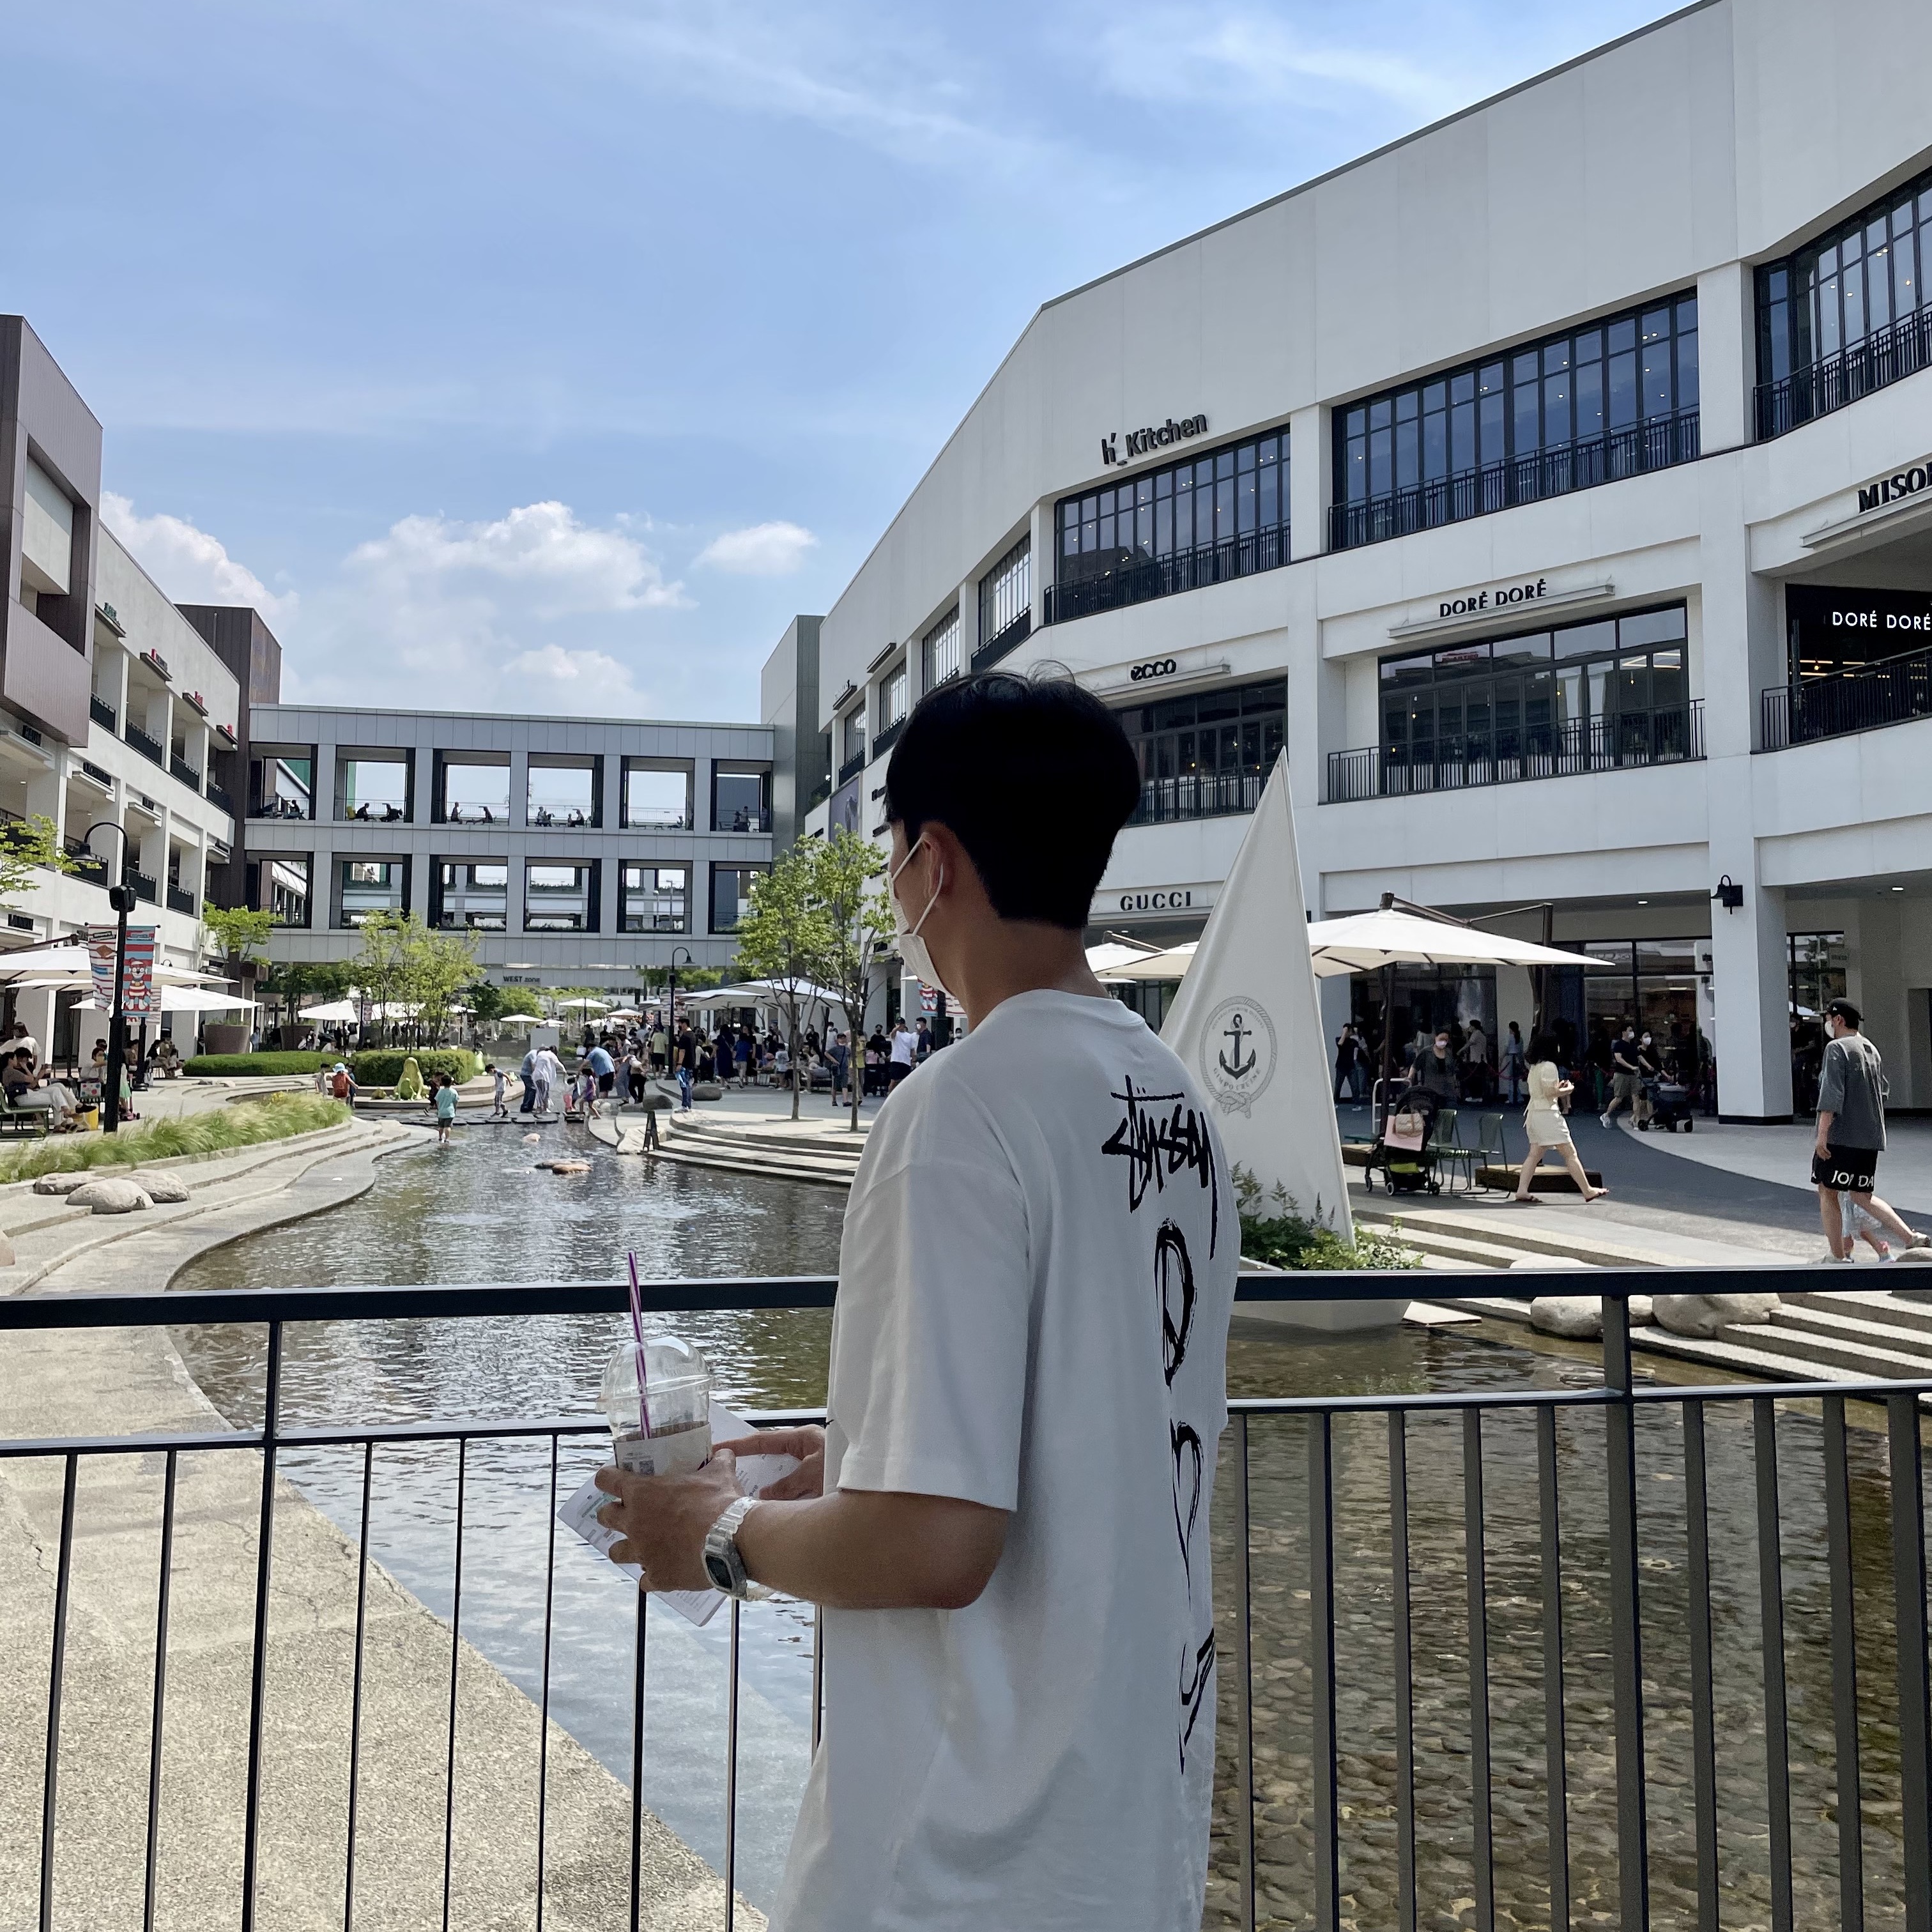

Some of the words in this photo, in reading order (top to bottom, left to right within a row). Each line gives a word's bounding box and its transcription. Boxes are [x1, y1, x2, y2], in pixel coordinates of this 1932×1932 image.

[1440, 591, 1488, 617] DORÉ
[1496, 578, 1547, 606] DORÉ
[1832, 610, 1877, 628] DORÉ
[1887, 613, 1931, 631] DORÉ
[1131, 659, 1176, 682] ecco
[1120, 891, 1191, 911] GUCCI
[1213, 1068, 1234, 1090] GIMPO
